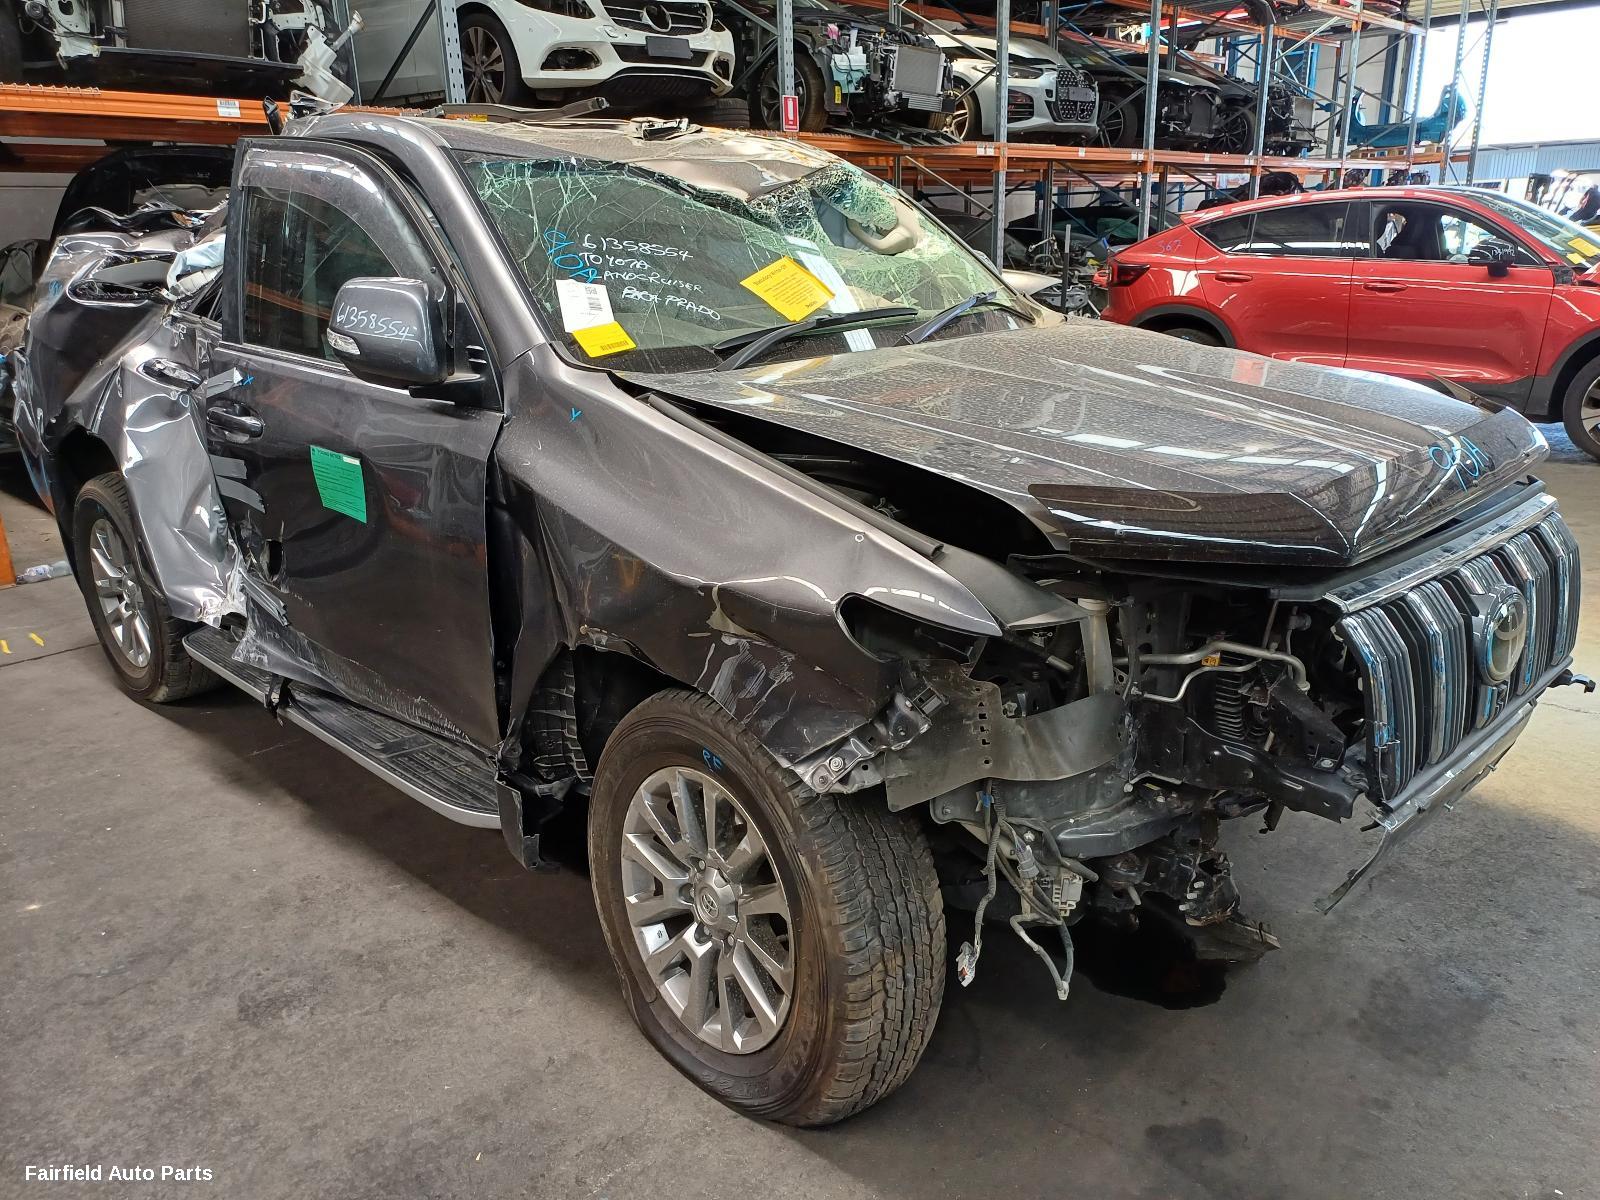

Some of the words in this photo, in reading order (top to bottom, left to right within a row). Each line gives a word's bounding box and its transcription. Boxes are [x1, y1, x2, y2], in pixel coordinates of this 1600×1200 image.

[582, 233, 694, 262] 61358554
[664, 294, 721, 321] PRADO
[336, 302, 415, 343] 61358554
